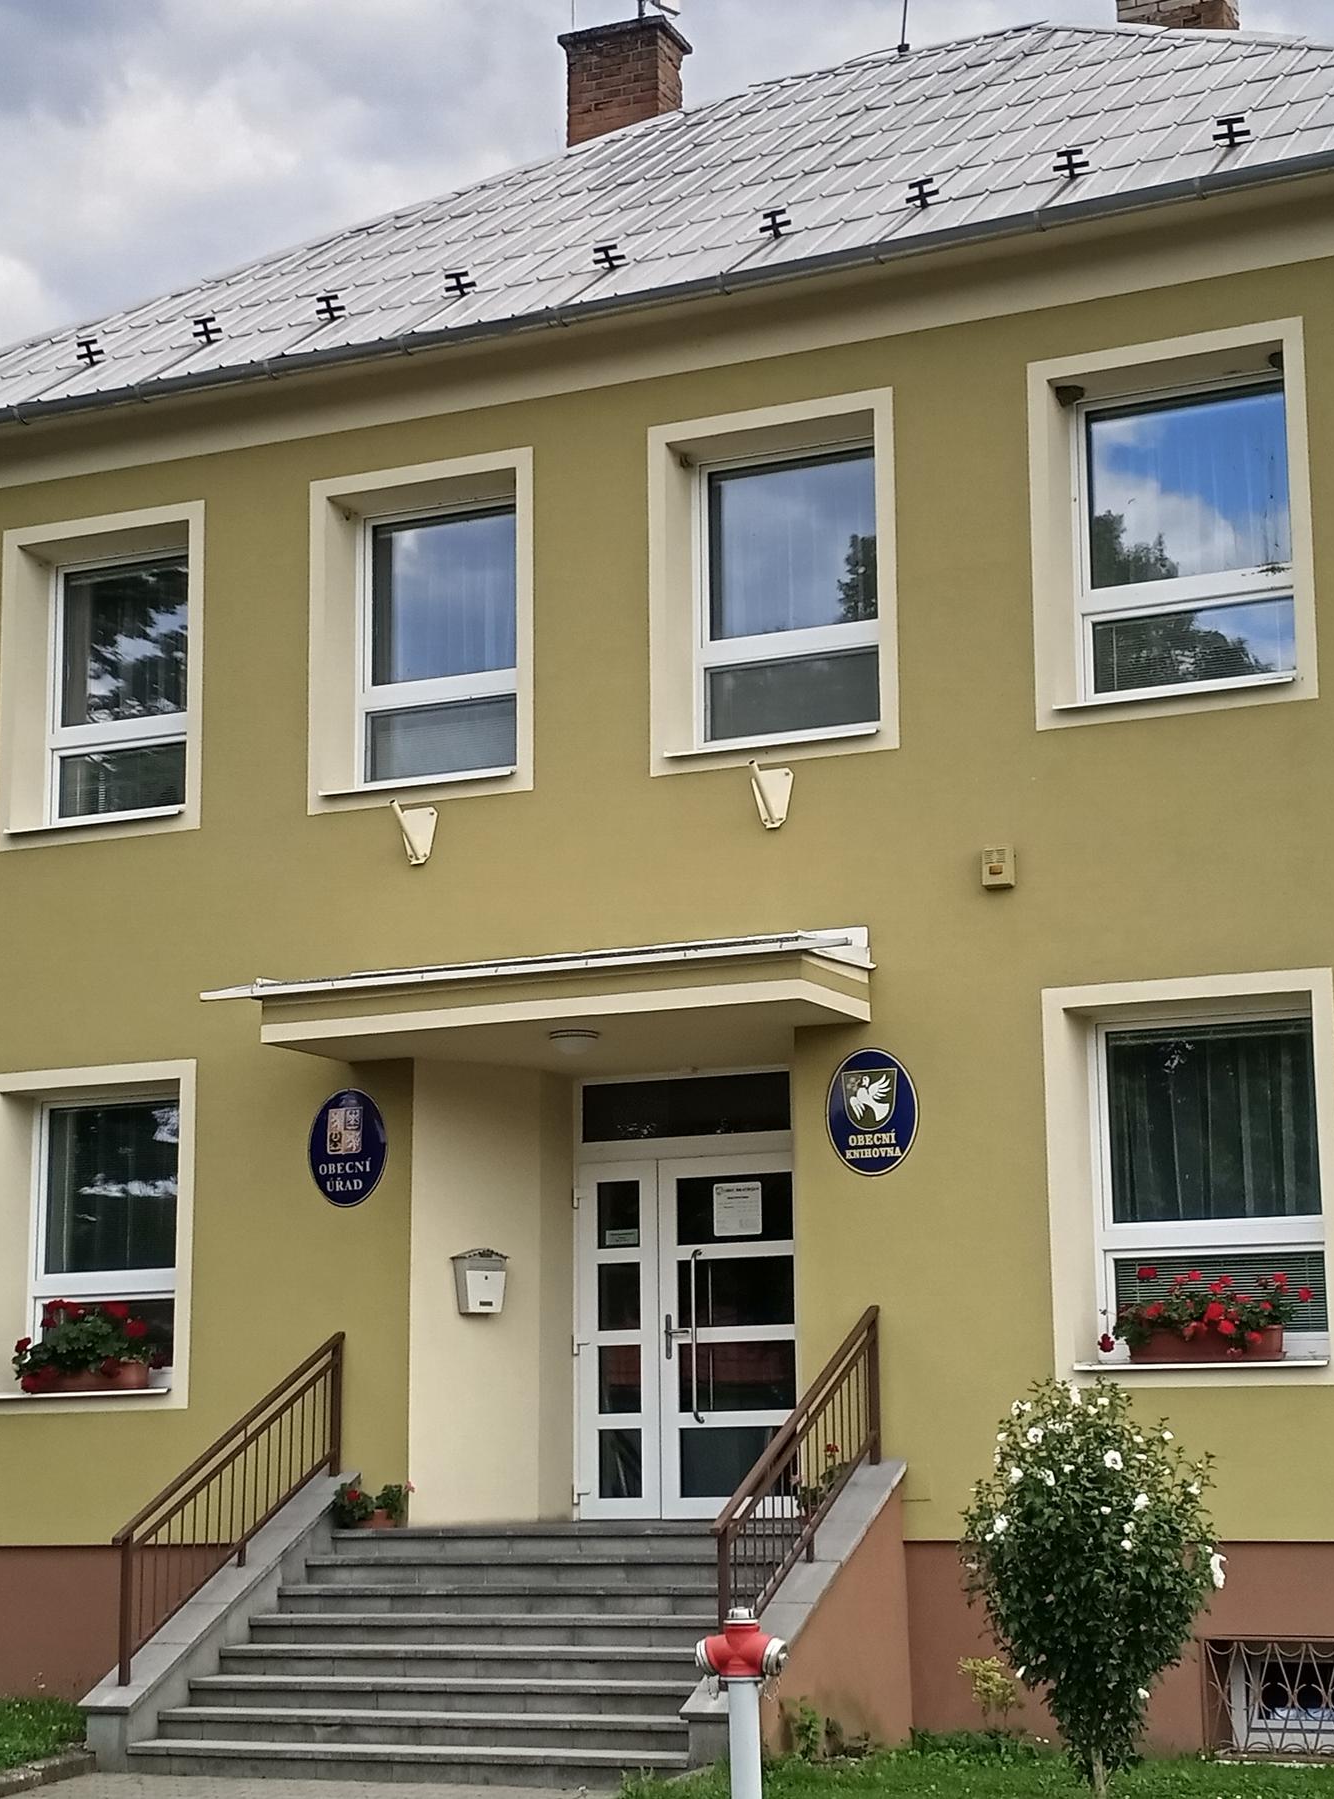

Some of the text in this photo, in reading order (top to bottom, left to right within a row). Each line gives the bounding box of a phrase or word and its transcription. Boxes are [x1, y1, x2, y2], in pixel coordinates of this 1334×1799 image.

[848, 1128, 896, 1147] OBECNÍ
[845, 1146, 902, 1159] KNIHOVNA
[318, 1157, 372, 1175] OBECNÍ
[327, 1177, 363, 1192] ÚŘAD
